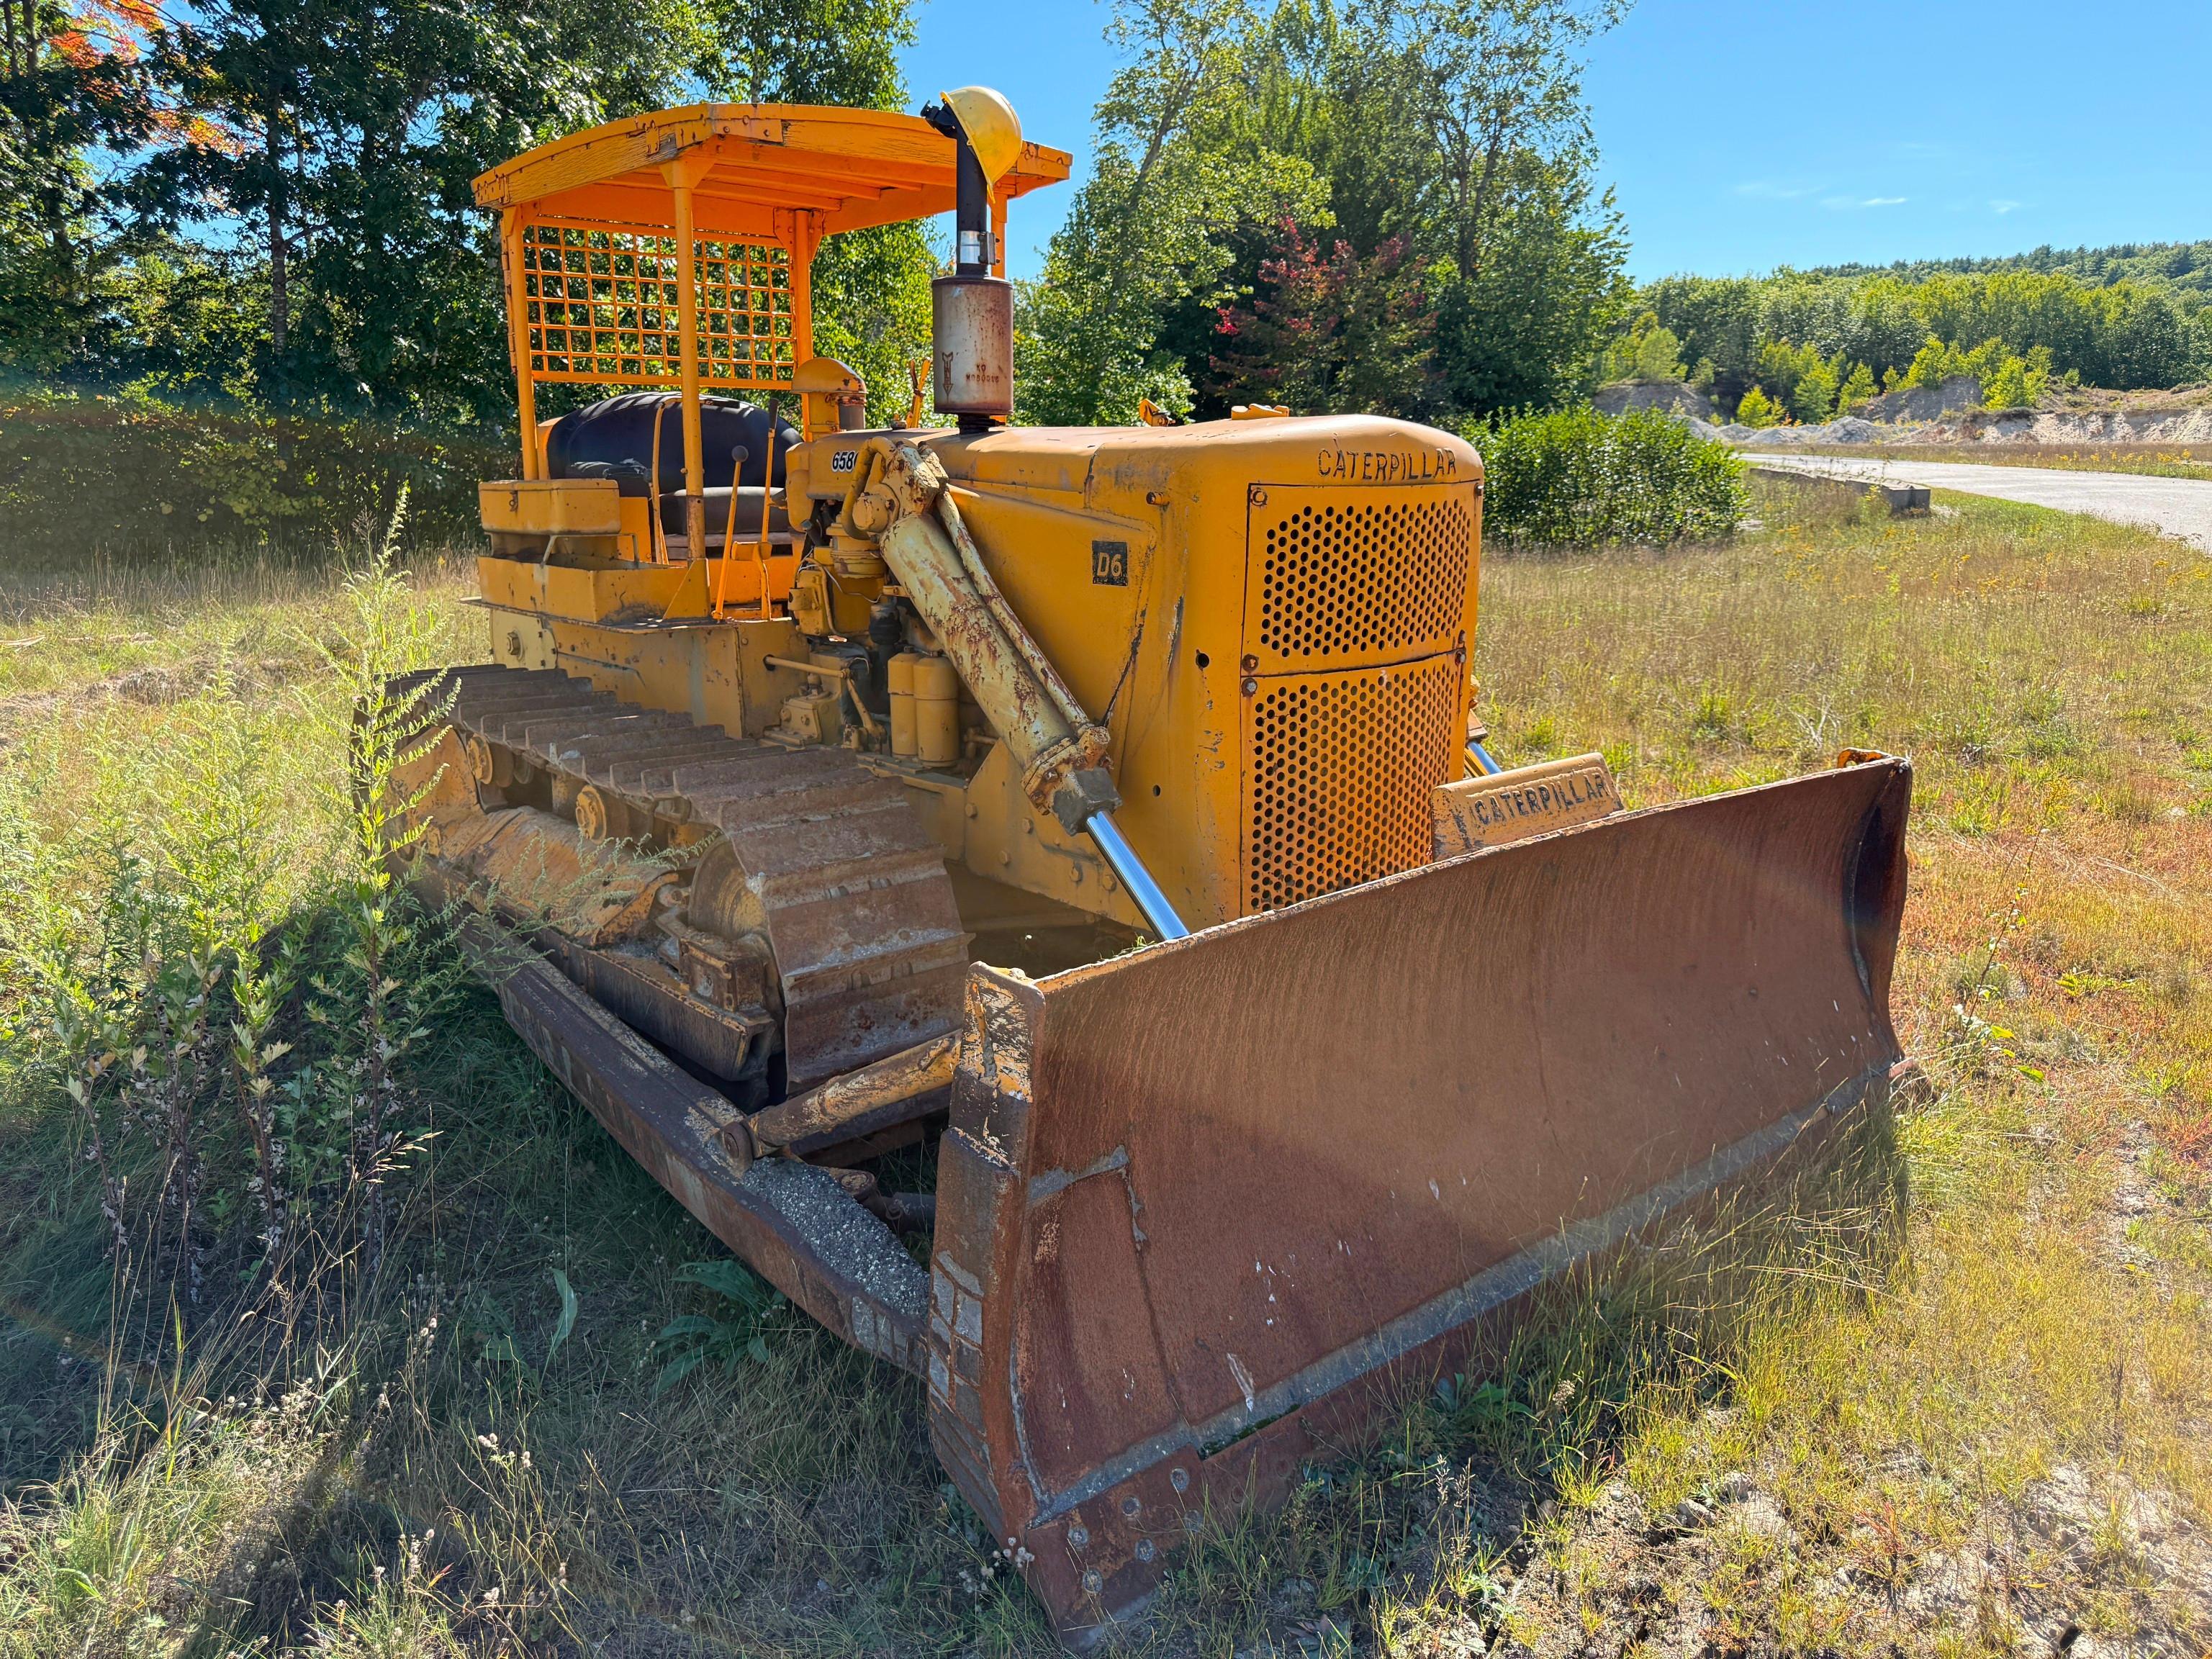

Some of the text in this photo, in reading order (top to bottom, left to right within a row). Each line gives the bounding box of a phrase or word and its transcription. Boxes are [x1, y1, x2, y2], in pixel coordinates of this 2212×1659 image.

[1318, 446, 1456, 481] CATERPILLAR
[1097, 552, 1122, 577] D6
[1474, 772, 1610, 826] CATERPILLAR
